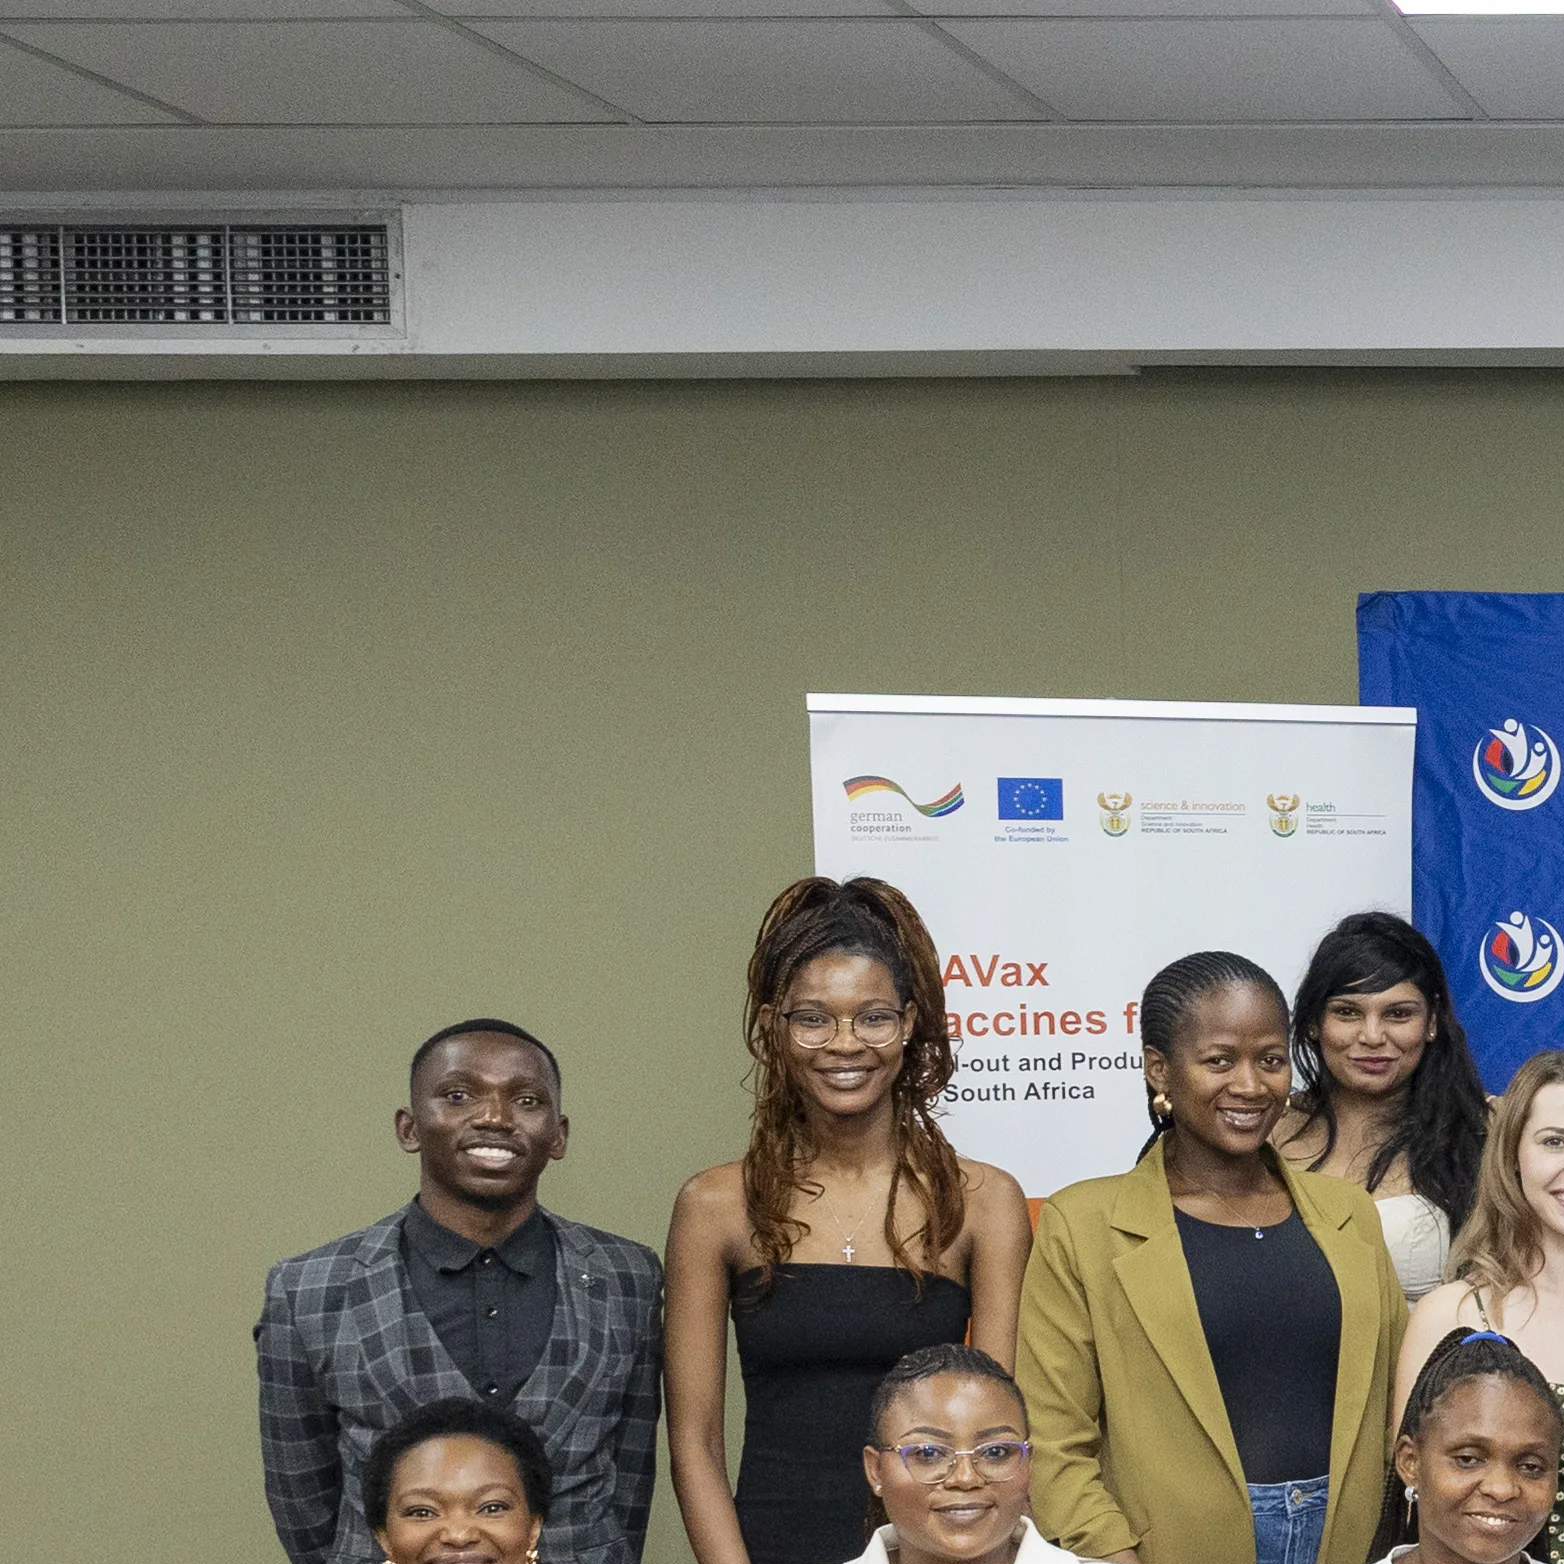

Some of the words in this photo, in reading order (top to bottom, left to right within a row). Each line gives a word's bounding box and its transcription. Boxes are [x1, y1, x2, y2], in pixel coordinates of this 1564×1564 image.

[1140, 800, 1178, 811] science
[1180, 800, 1189, 811] &
[1306, 801, 1336, 813] health
[850, 812, 903, 825] german
[850, 823, 912, 834] cooperation
[941, 954, 1050, 987] AVax
[946, 1003, 1108, 1037] accines
[954, 1054, 1011, 1073] l-out
[1018, 1052, 1062, 1072] and
[1071, 1051, 1144, 1071] Produ
[943, 1082, 1016, 1103] South
[1024, 1081, 1095, 1101] Africa
